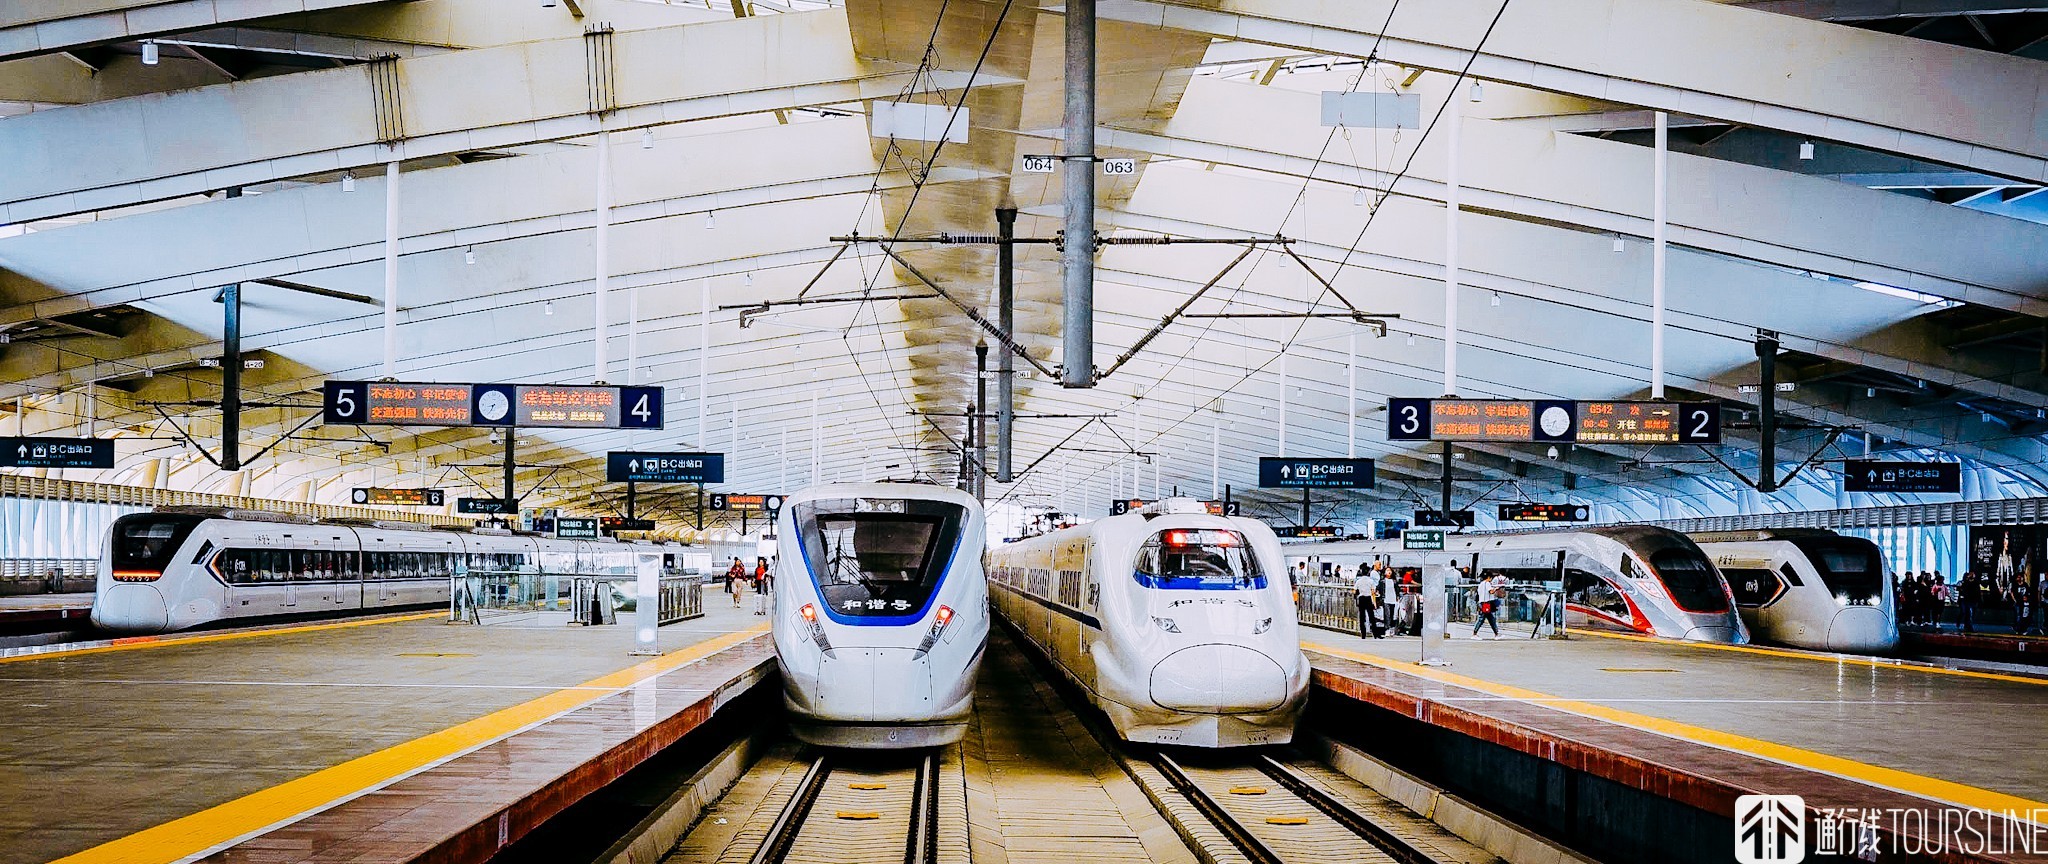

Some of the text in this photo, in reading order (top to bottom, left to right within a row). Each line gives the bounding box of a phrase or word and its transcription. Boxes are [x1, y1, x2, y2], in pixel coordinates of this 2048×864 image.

[1024, 158, 1053, 171] 064
[1105, 161, 1133, 174] 063
[371, 388, 467, 400] 不忘初心 牢记使命
[336, 389, 355, 417] 5
[631, 394, 651, 422] 4
[422, 408, 467, 419] 铁路先行
[1434, 404, 1530, 417] 不忘初心 牢记使命
[1589, 404, 1640, 415] G542 次
[1401, 405, 1419, 433] 3
[1617, 420, 1637, 430] 开往
[1690, 410, 1709, 437] 2
[1485, 423, 1530, 436] 铁路先行
[660, 459, 703, 469] B·C出站口
[1311, 464, 1354, 474] B·C出站口
[431, 492, 440, 504] 6
[714, 496, 722, 508] 5
[1116, 502, 1125, 513] 3
[1227, 504, 1236, 515] 2
[1503, 507, 1509, 518] 1
[842, 599, 911, 610] 和谐号
